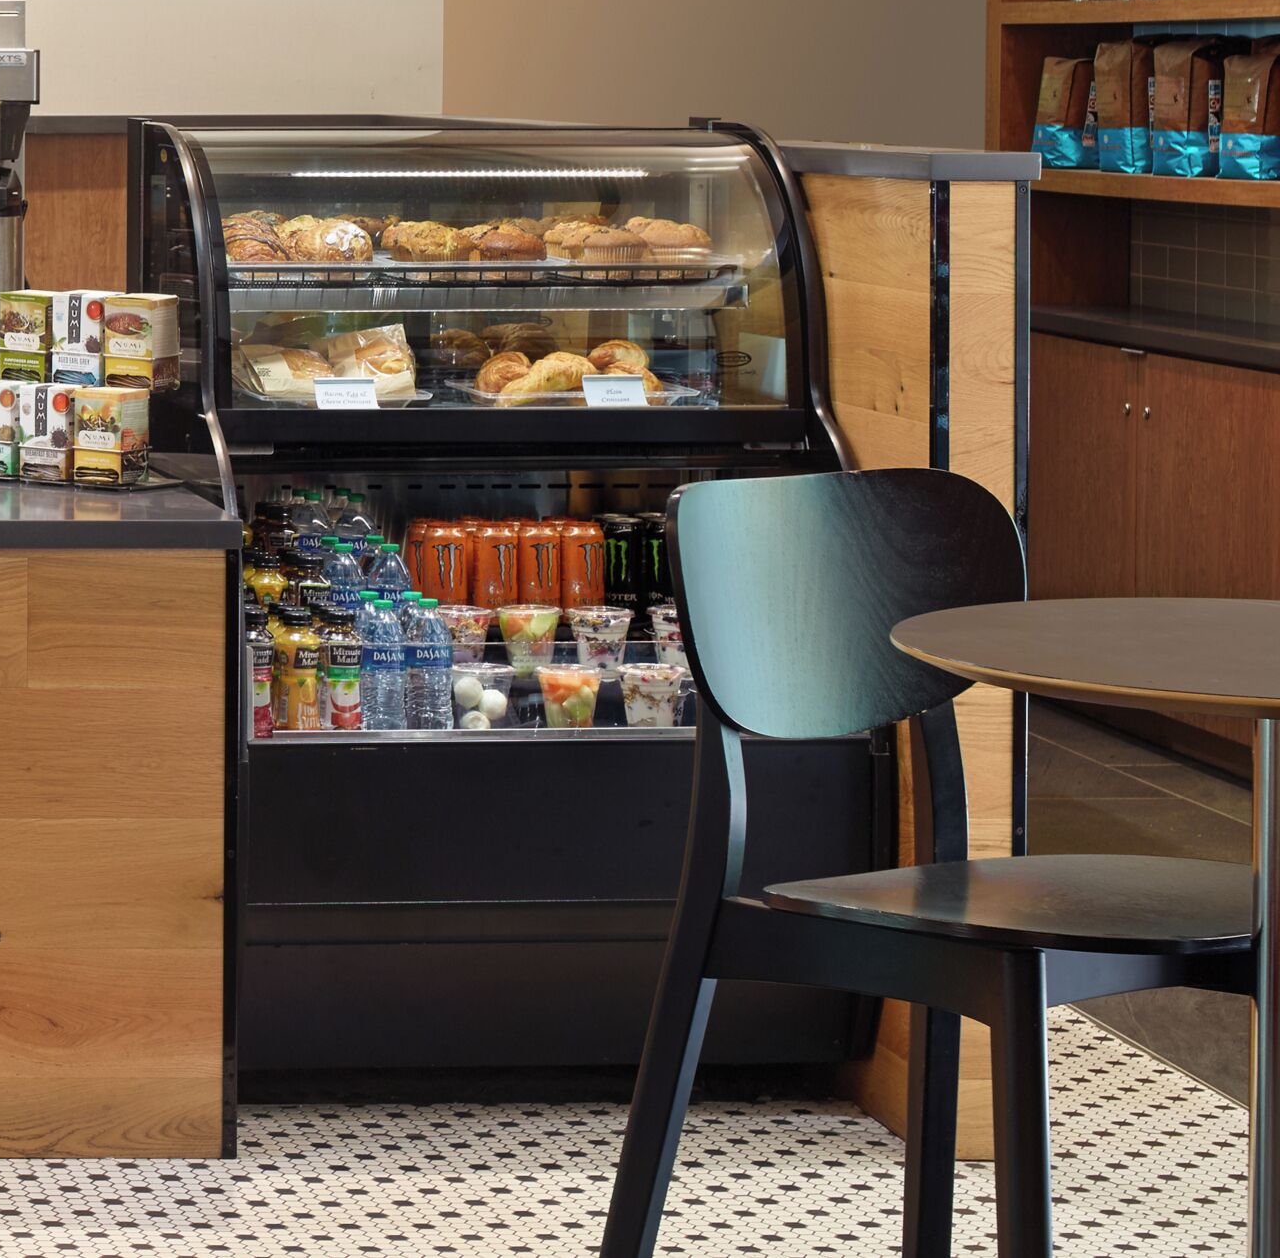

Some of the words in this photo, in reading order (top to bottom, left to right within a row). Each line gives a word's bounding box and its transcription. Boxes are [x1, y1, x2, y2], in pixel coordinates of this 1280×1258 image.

[70, 299, 79, 338] NUMI
[37, 393, 45, 430] NUMI
[336, 655, 358, 663] Maid
[417, 648, 449, 660] DASANI
